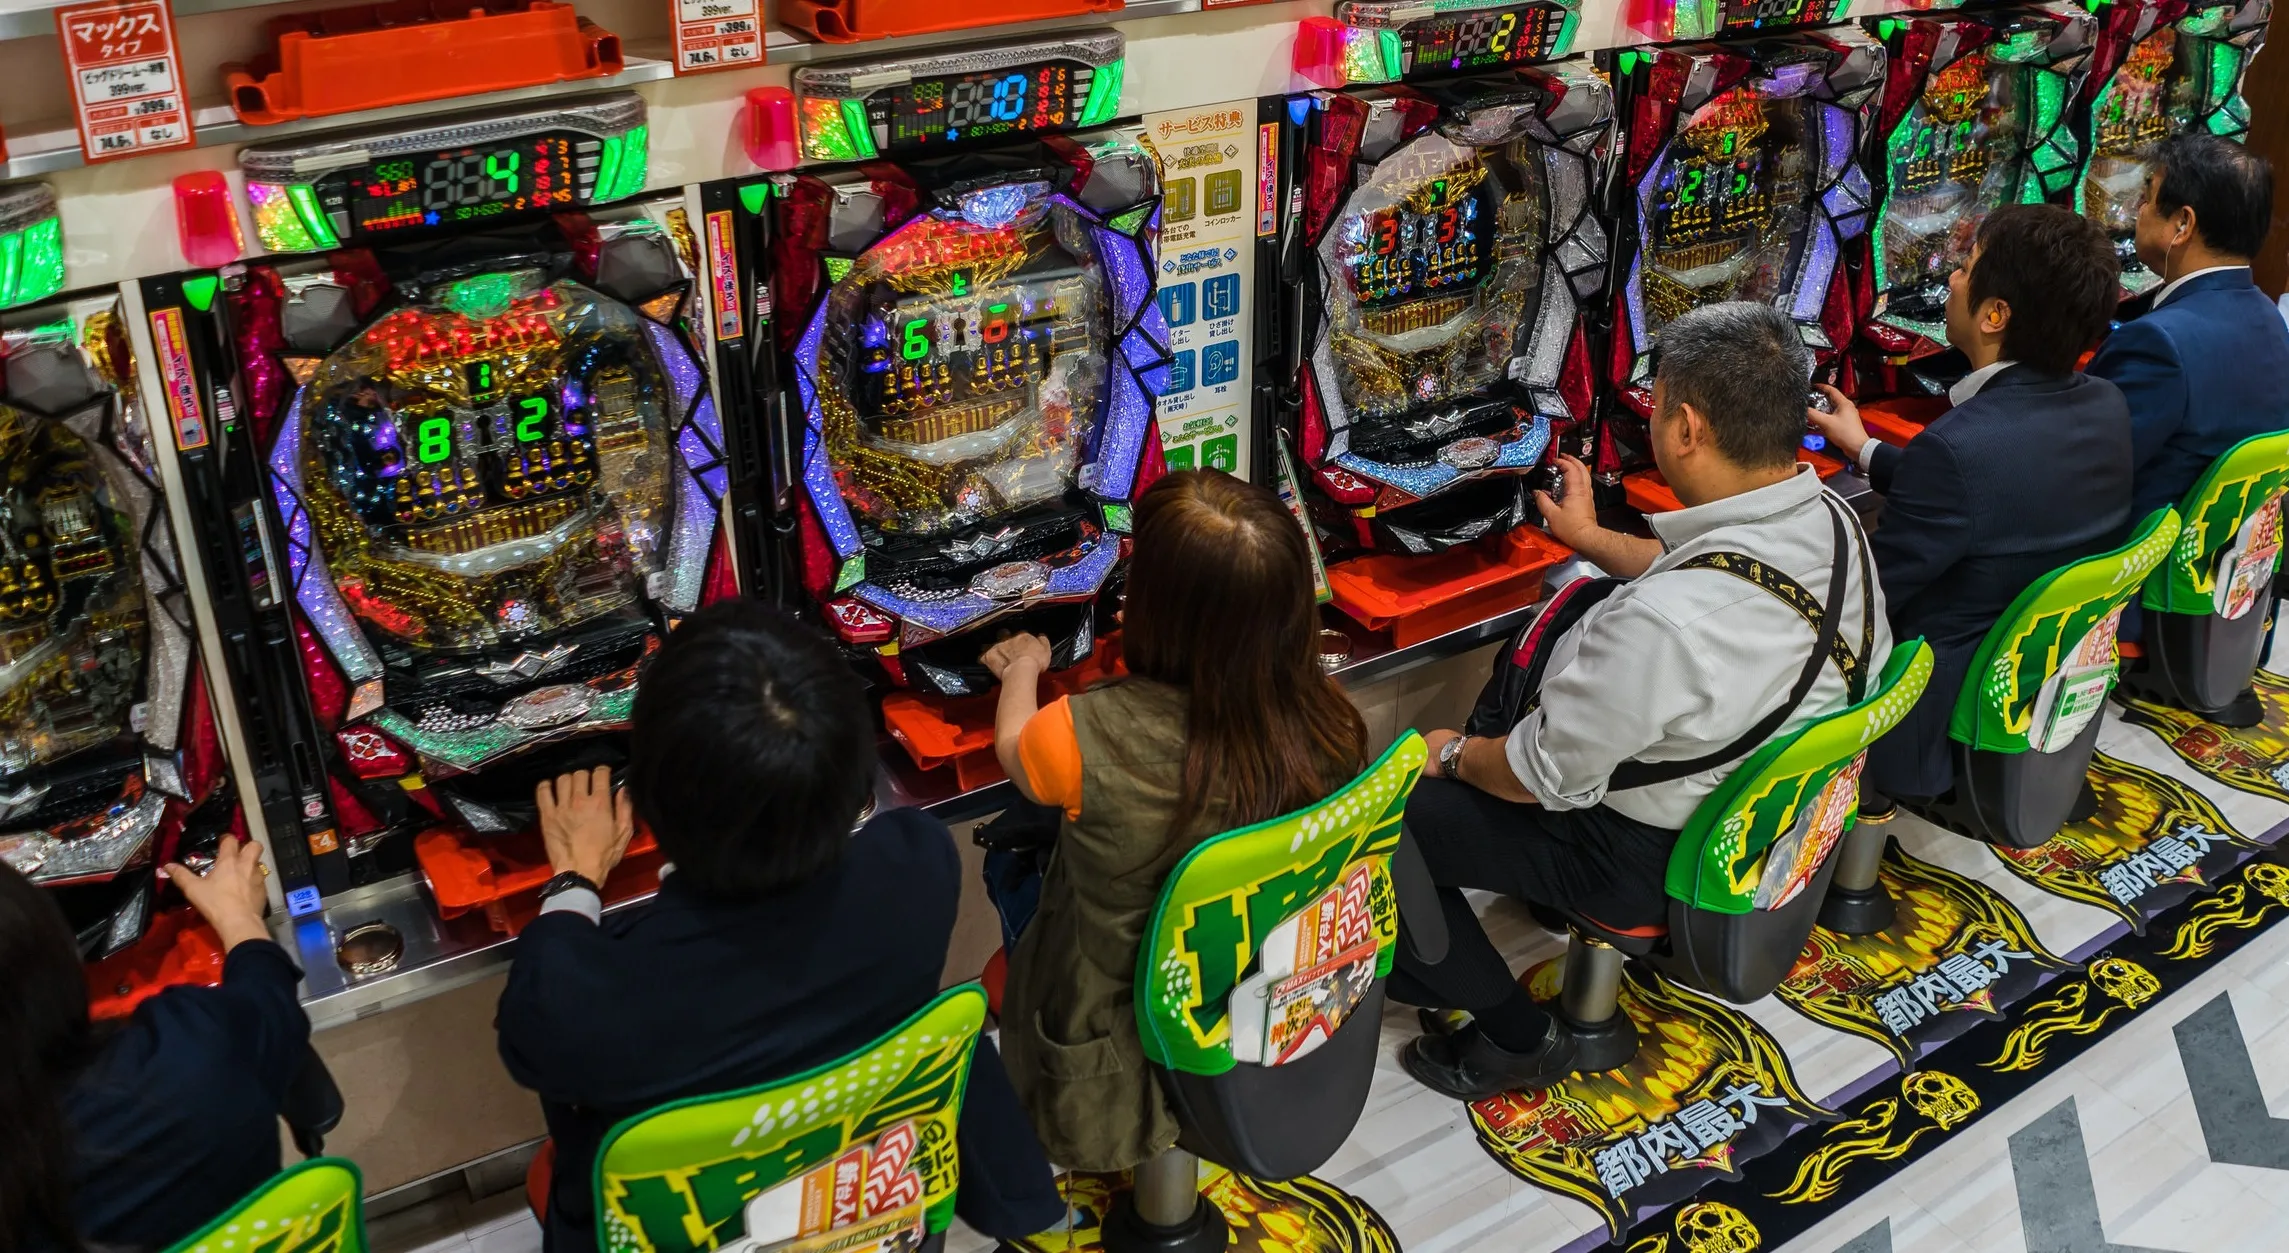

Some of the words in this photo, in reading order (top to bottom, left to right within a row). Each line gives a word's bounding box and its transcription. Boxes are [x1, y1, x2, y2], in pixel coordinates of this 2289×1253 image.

[72, 13, 161, 43] マックス
[1491, 13, 1516, 53] 2
[101, 39, 142, 58] タイプ
[730, 47, 749, 58] なし
[990, 74, 1027, 120] 10
[872, 111, 886, 120] 121
[1158, 109, 1244, 140] サービス特典
[150, 128, 173, 141] なし
[486, 152, 520, 193] 4
[1163, 223, 1190, 236] 各台での
[1204, 215, 1242, 228] コインロッカー
[1162, 231, 1196, 243] 帯電話充電
[1172, 330, 1190, 338] イター
[1210, 319, 1234, 330] ひざ掛け
[1172, 337, 1190, 346] し出し
[1209, 327, 1234, 338] 貸し出し
[1214, 385, 1227, 394] 耳栓
[1157, 392, 1195, 408] タオル貸し出し
[516, 397, 548, 442] 2
[418, 416, 451, 464] 8
[2100, 824, 2231, 905] 都内最大
[1874, 939, 2035, 1036] 都内最大
[1595, 1083, 1789, 1199] 都内最大
